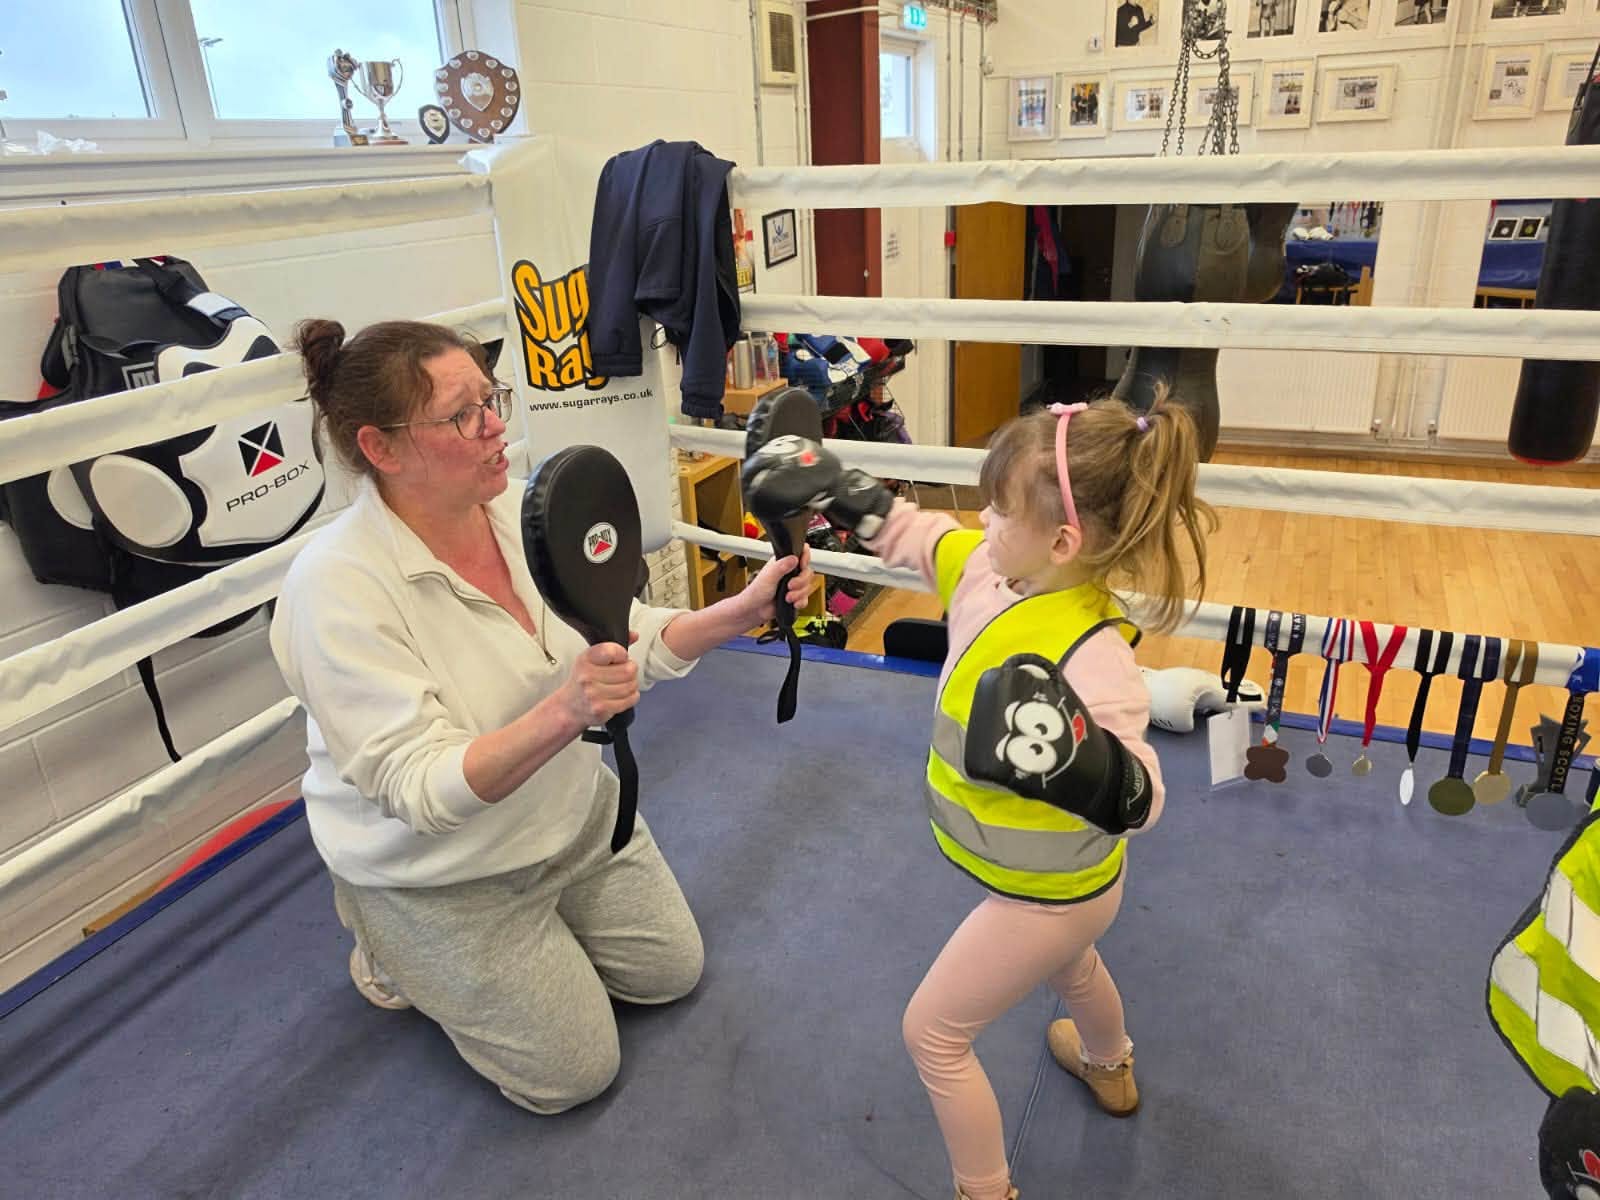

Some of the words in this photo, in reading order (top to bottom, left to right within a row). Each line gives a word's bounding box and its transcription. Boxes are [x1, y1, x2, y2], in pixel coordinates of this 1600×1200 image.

[512, 260, 590, 343] Sug
[529, 389, 653, 412] www.sugarrays.co.uk
[226, 459, 309, 512] PRO-BOX
